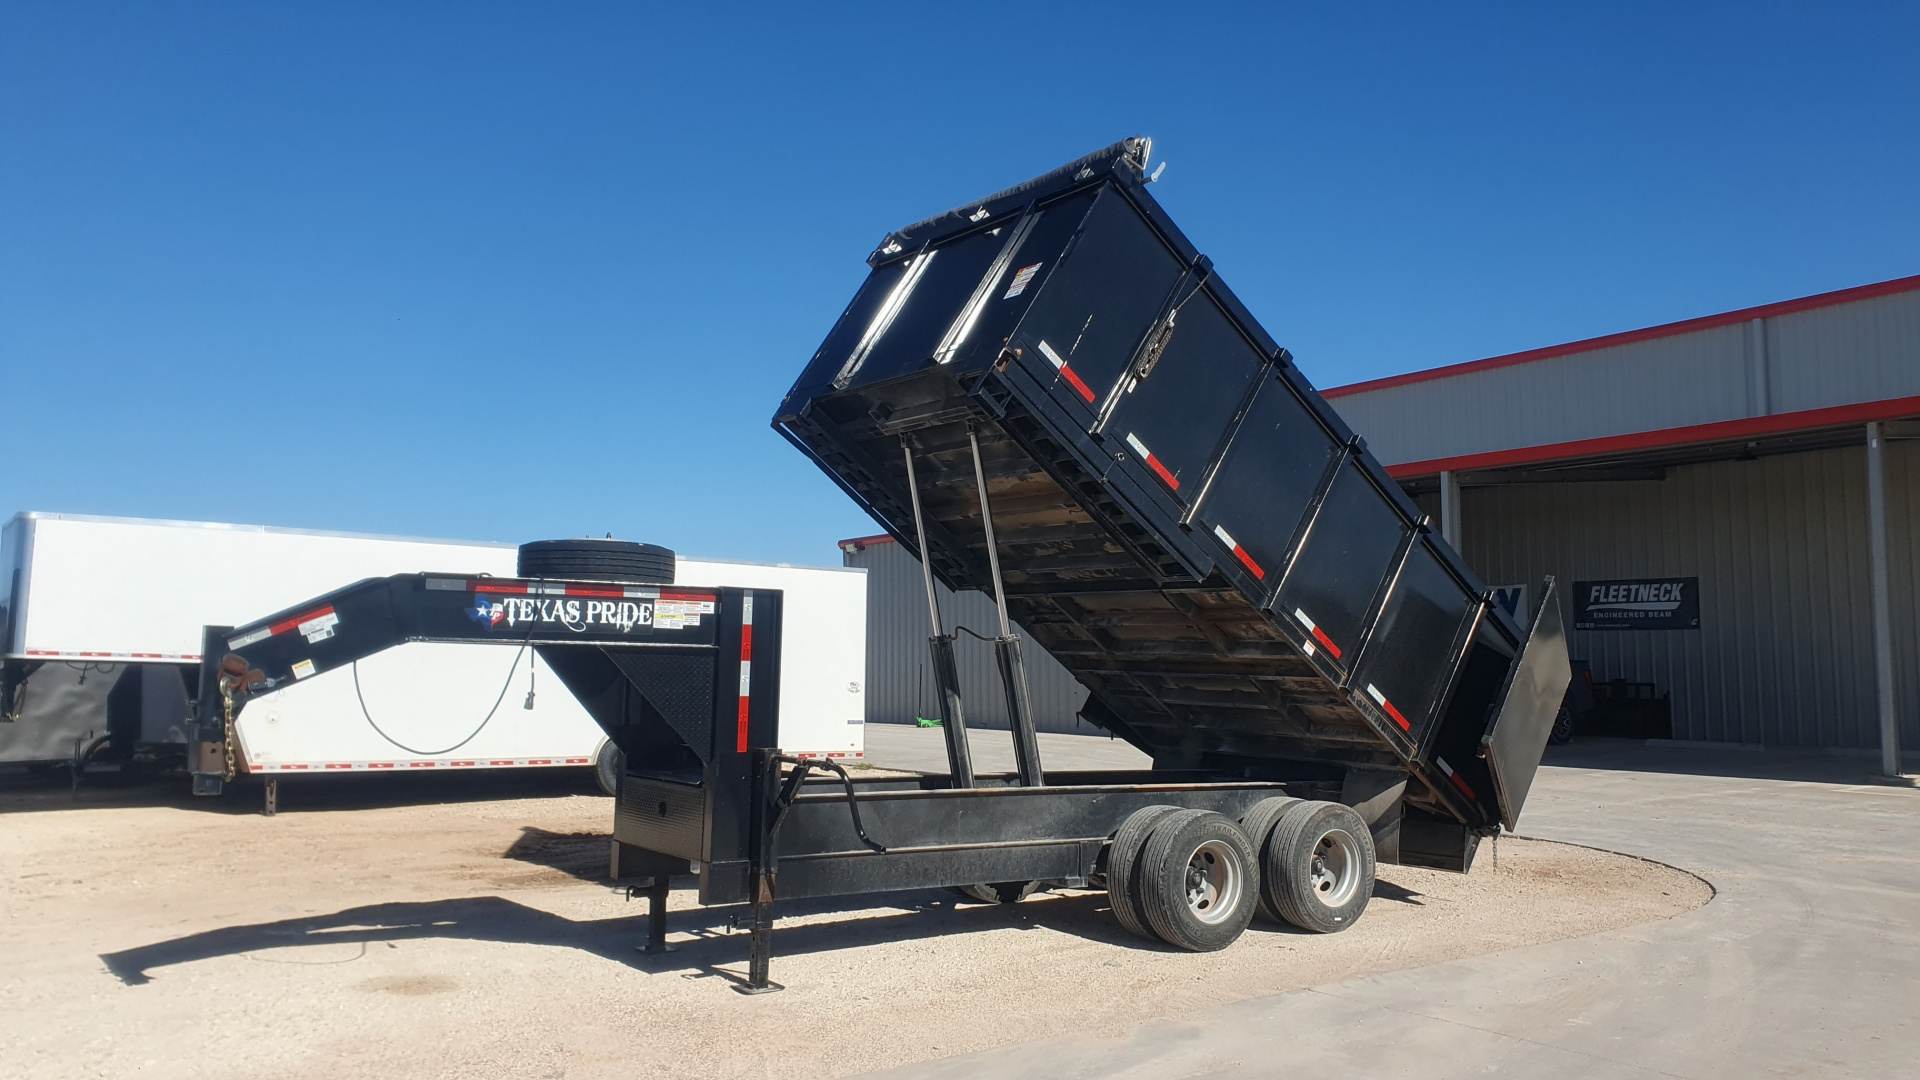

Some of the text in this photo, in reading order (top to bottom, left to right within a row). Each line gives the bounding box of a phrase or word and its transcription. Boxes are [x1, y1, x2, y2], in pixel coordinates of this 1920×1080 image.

[1590, 583, 1684, 602] FLEETNECK
[503, 598, 586, 632] TEXAS
[587, 601, 653, 632] PRIDE
[1212, 825, 1251, 857] TRAILFINDER
